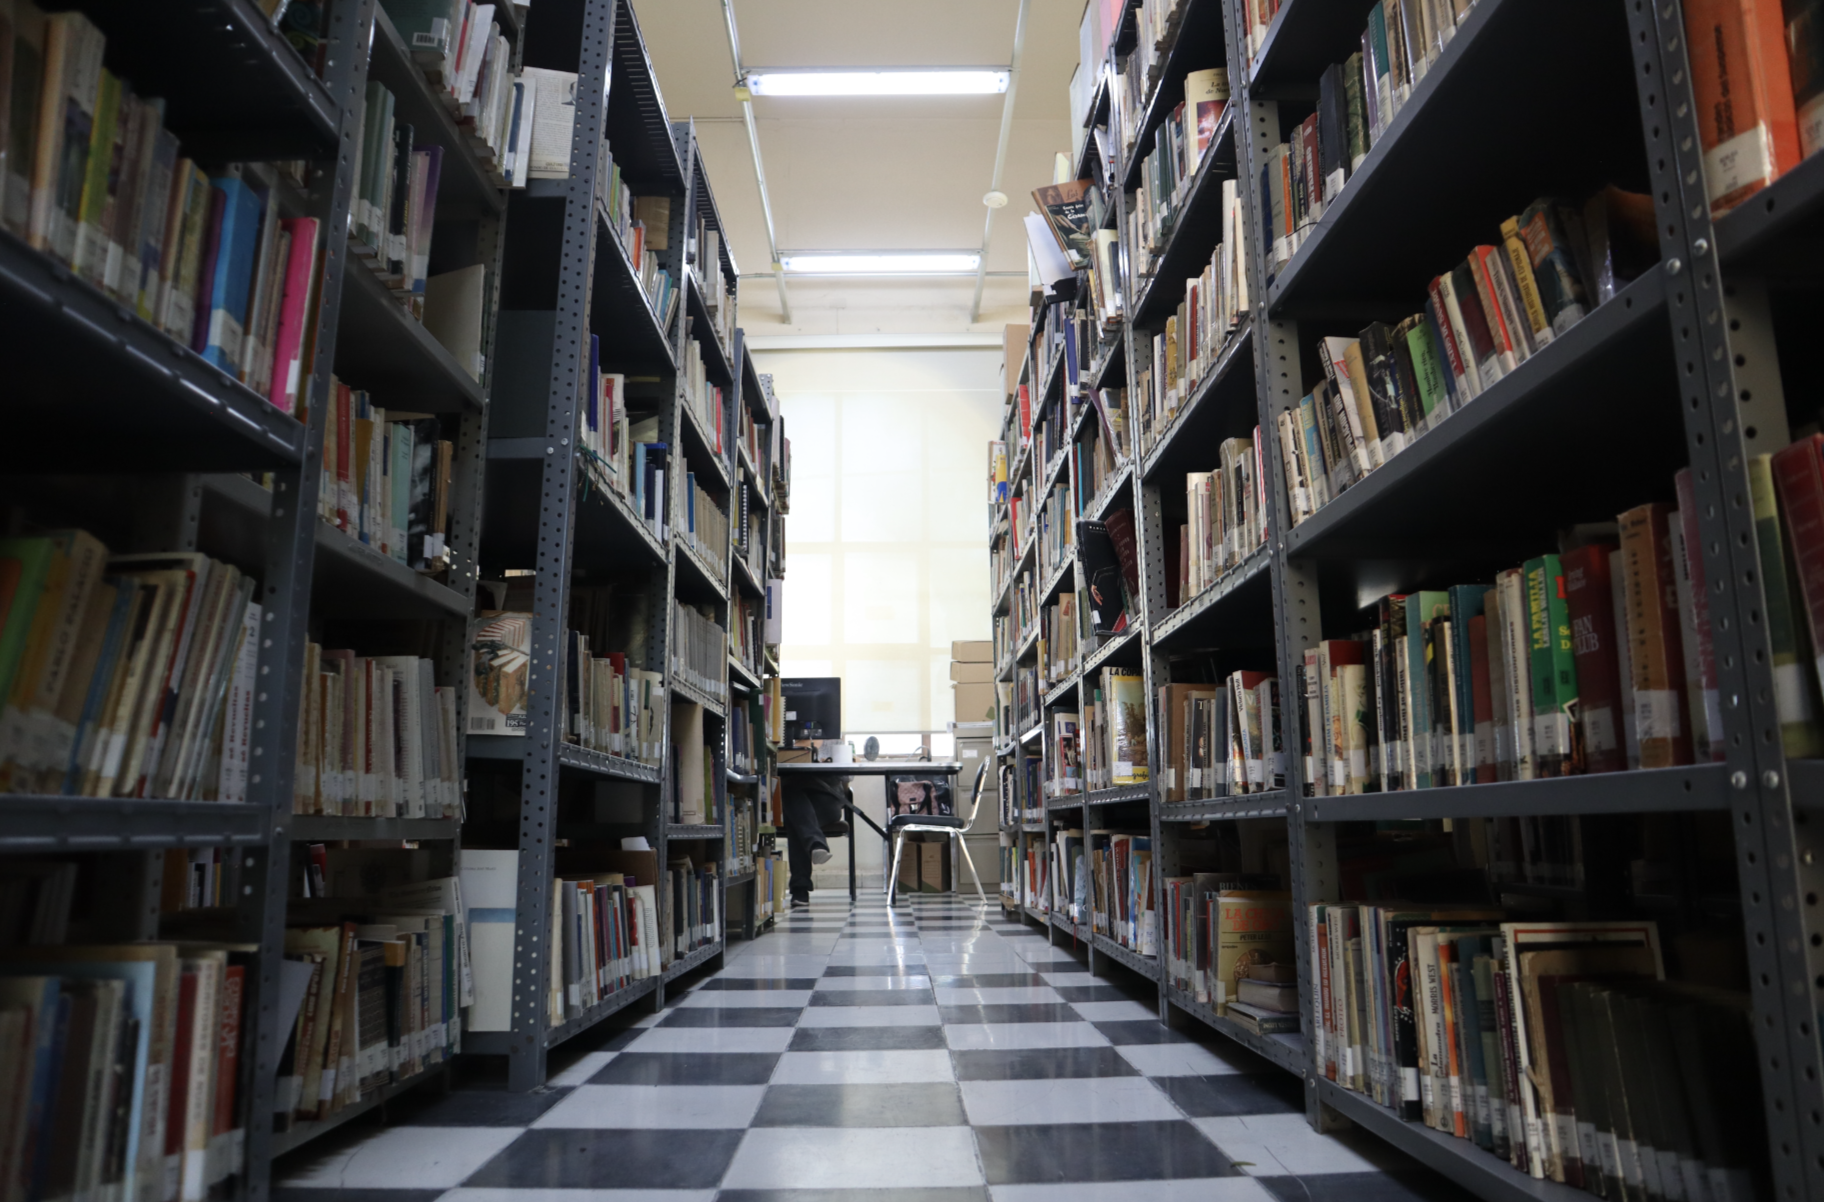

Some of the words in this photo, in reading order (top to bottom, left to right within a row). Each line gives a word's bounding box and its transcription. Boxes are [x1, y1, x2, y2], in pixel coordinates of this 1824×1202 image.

[1522, 283, 1537, 310] HISTORIAS
[1528, 568, 1542, 629] FAMILIA
[46, 632, 69, 694] PABLO
[65, 547, 92, 624] PALACIO
[1573, 614, 1594, 637] FAN
[1109, 668, 1121, 676] LA
[230, 685, 239, 744] Revueltas
[242, 690, 251, 747] Revueltas
[1225, 908, 1242, 920] LA
[1232, 920, 1250, 931] DE
[1240, 933, 1258, 942] PETER
[1428, 963, 1436, 983] WEST
[1431, 986, 1440, 1015] MORRIS
[1431, 1054, 1439, 1067] La
